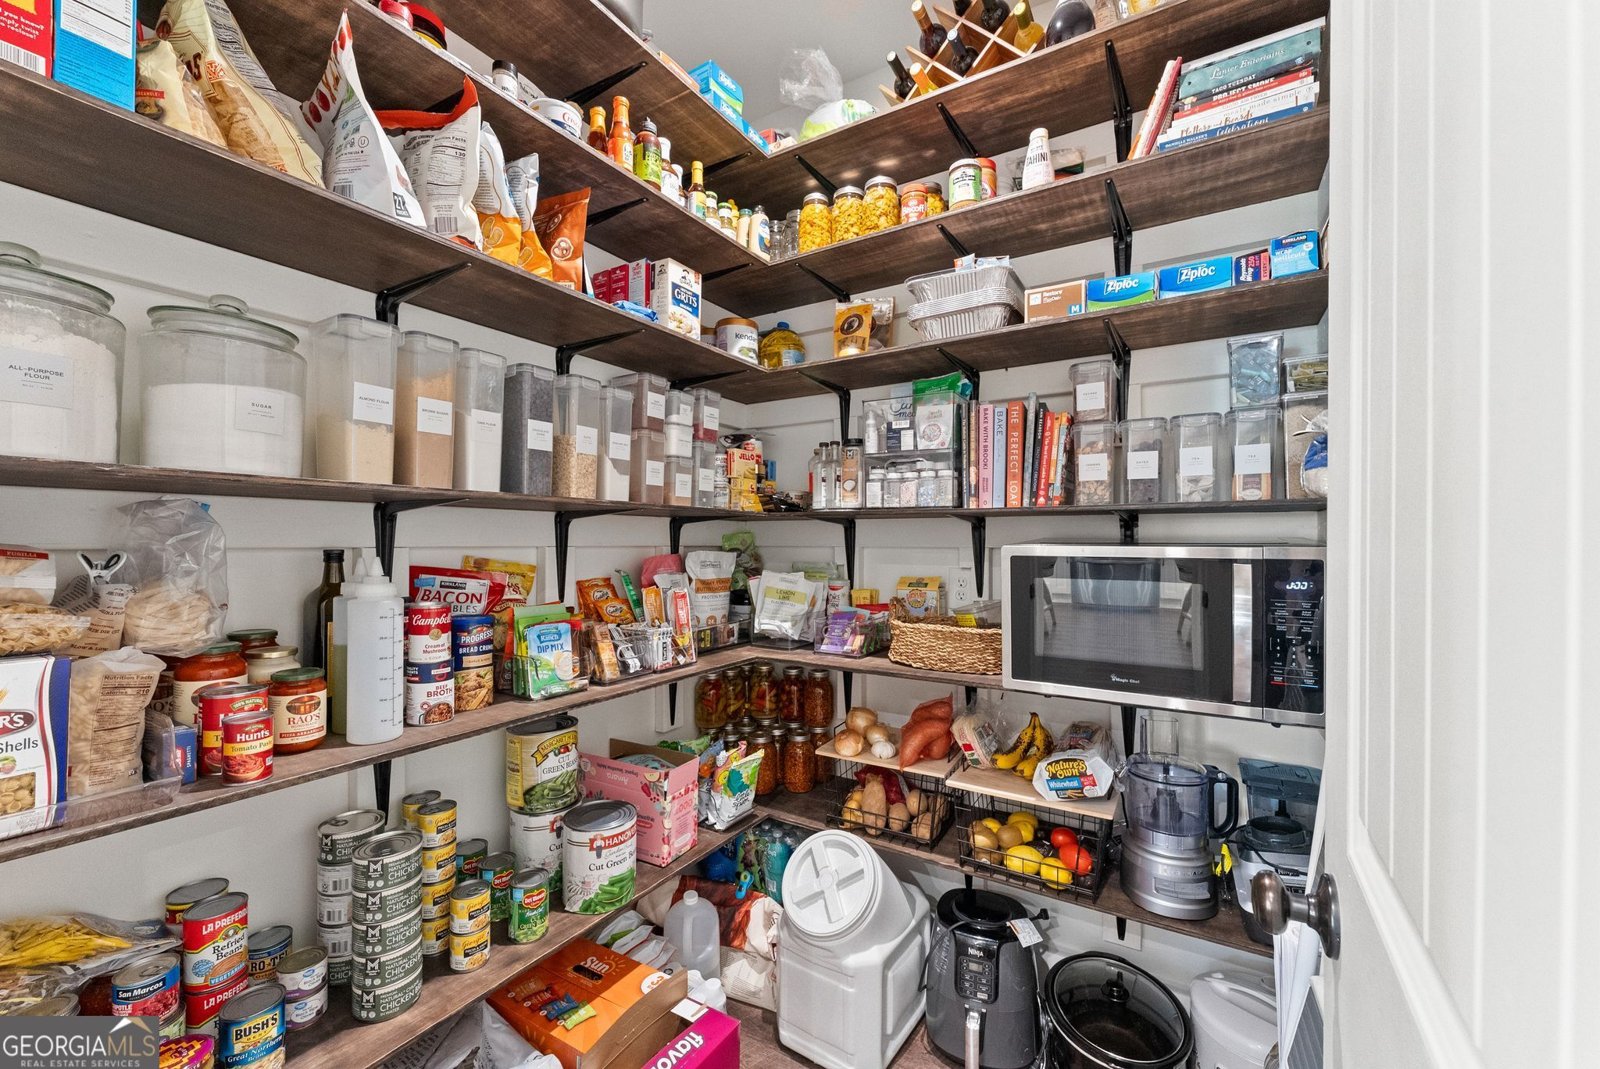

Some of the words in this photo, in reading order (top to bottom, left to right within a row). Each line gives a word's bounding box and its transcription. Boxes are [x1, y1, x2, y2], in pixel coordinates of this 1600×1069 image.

[1180, 264, 1216, 282] Ziploc
[1106, 278, 1139, 294] Ziploc
[674, 288, 698, 308] GRITS
[1071, 305, 1080, 313] M
[8, 364, 65, 378] ALL-PURPOSE
[24, 372, 51, 382] FLOUR
[251, 402, 273, 410] SUGAR
[1010, 406, 1019, 424] THE
[996, 410, 1004, 437] BAKE
[1010, 432, 1019, 473] PERFECT
[1009, 480, 1018, 506] LOAF
[441, 581, 466, 589] KIRKLAND
[776, 588, 796, 596] LEMON
[421, 588, 483, 604] BACON
[452, 604, 478, 614] BLES
[461, 629, 493, 644] PROGRESS
[459, 646, 478, 654] BREAD
[537, 645, 550, 654] DIP
[550, 643, 565, 652] MIX
[426, 688, 453, 698] BROTH
[287, 713, 321, 726] RAO'S
[231, 744, 258, 753] Tomato
[558, 754, 570, 764] CUT
[542, 764, 565, 775] GREEN
[1046, 760, 1087, 778] Nature's
[1057, 768, 1080, 779] Own
[336, 846, 354, 856] CHIC
[549, 842, 563, 852] Cut
[388, 861, 419, 880] CHICKEN
[588, 863, 604, 872] Cut
[606, 857, 628, 868] Green
[386, 894, 417, 913] CHICKEN
[202, 924, 214, 935] LA
[386, 926, 418, 945] CHICKEN
[212, 933, 245, 954] Refried
[216, 945, 243, 961] Beans
[968, 946, 984, 958] NINJA
[385, 958, 417, 978] CHICKEN
[583, 956, 610, 974] Sun
[330, 971, 352, 980] CHICK
[118, 990, 132, 998] San
[133, 981, 163, 996] Marcos
[204, 998, 215, 1010] LA
[380, 992, 415, 1012] CHICKEN
[234, 1012, 278, 1042] BUSH'S
[228, 1052, 248, 1063] Great
[250, 1035, 283, 1056] Northern
[651, 1031, 704, 1069] flavo
